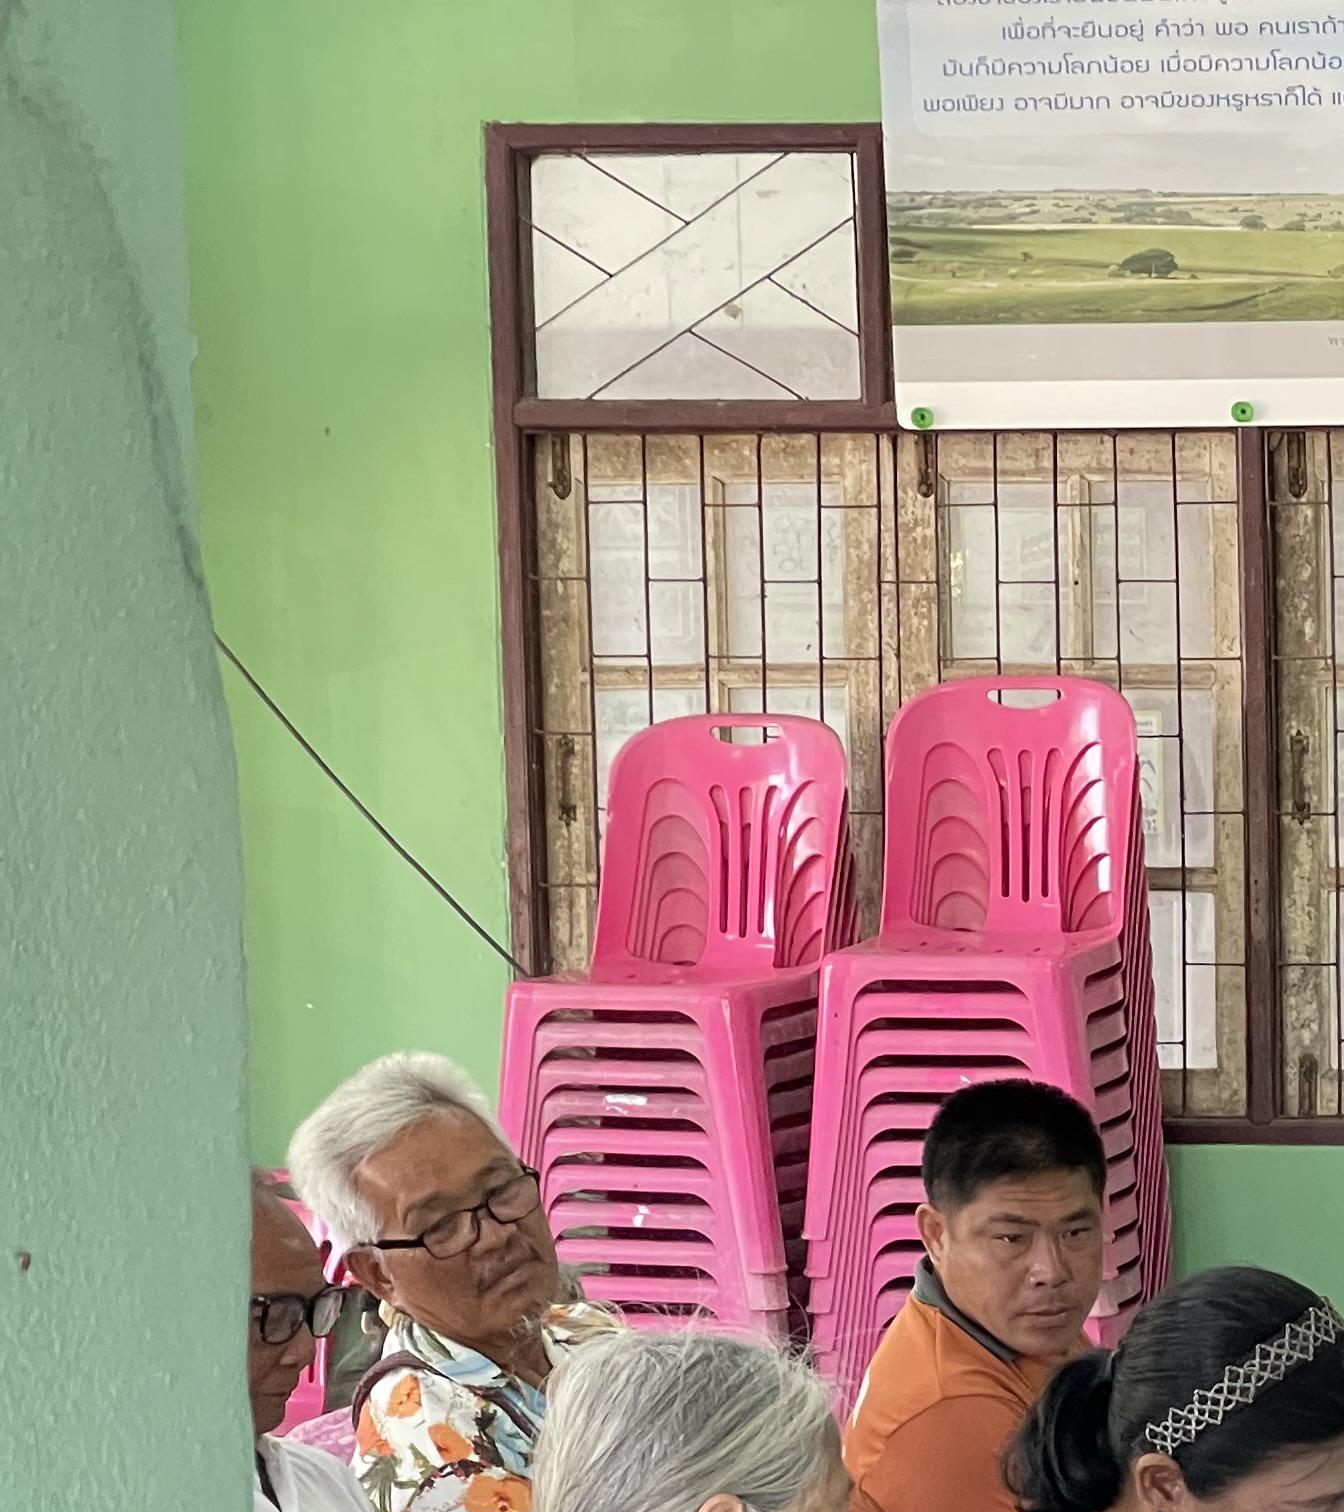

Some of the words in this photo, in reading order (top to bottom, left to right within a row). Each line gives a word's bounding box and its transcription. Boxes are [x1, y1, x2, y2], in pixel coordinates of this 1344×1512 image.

[1155, 17, 1205, 38] คำว่า
[1215, 21, 1249, 37] พอ
[923, 94, 1004, 113] พอเพียง
[1014, 92, 1111, 111] อาจมีมาก
[1120, 84, 1323, 112] อาจมีของหรูหราก็ได้
